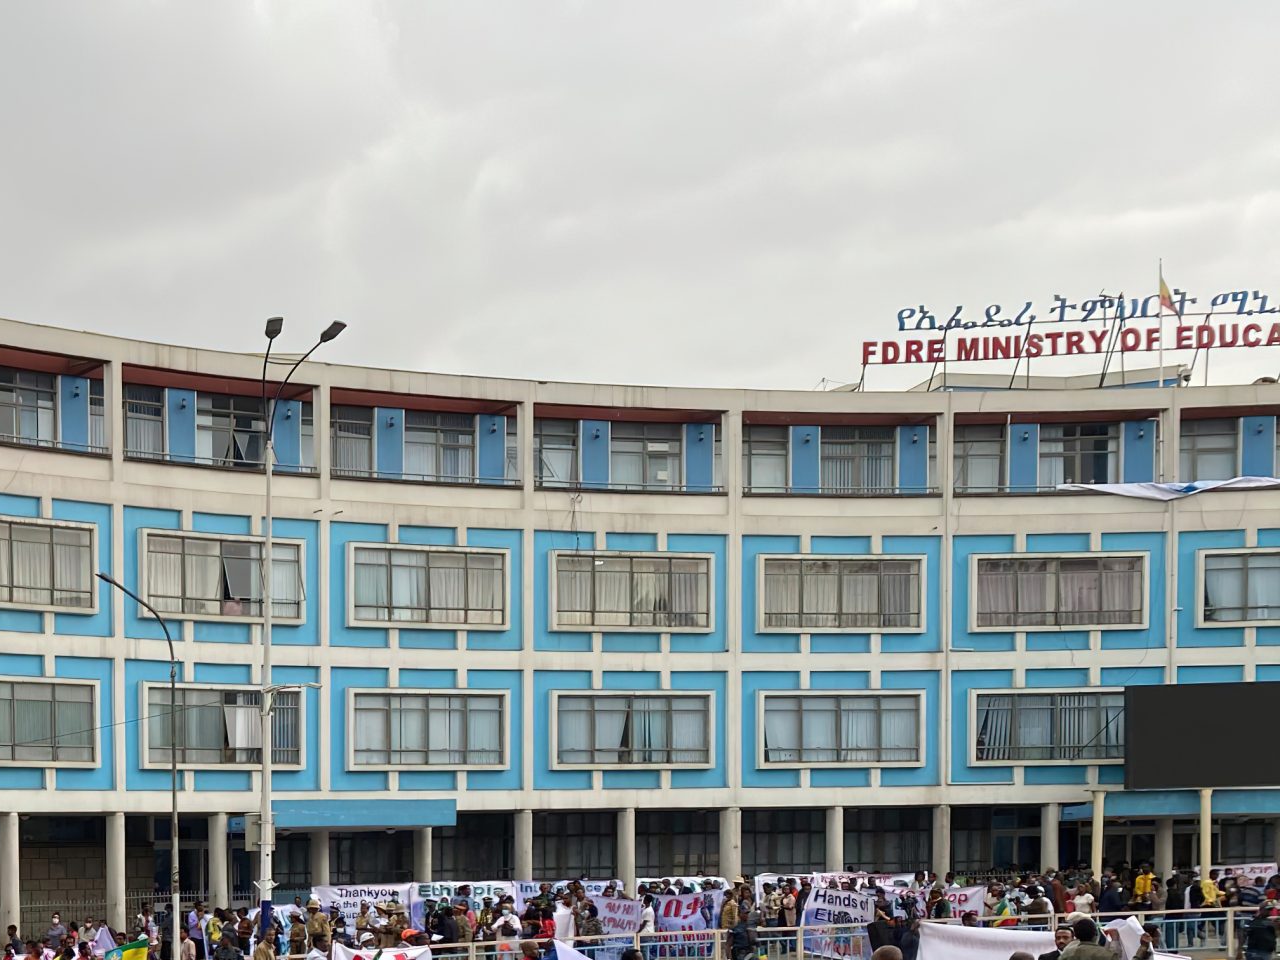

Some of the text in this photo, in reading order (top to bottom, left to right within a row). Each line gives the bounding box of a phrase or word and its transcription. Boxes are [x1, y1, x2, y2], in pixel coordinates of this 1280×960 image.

[862, 338, 946, 365] FDRE
[957, 329, 1109, 361] MINISTRY
[1121, 327, 1160, 351] OF
[343, 900, 358, 909] the
[814, 890, 857, 908] Hands
